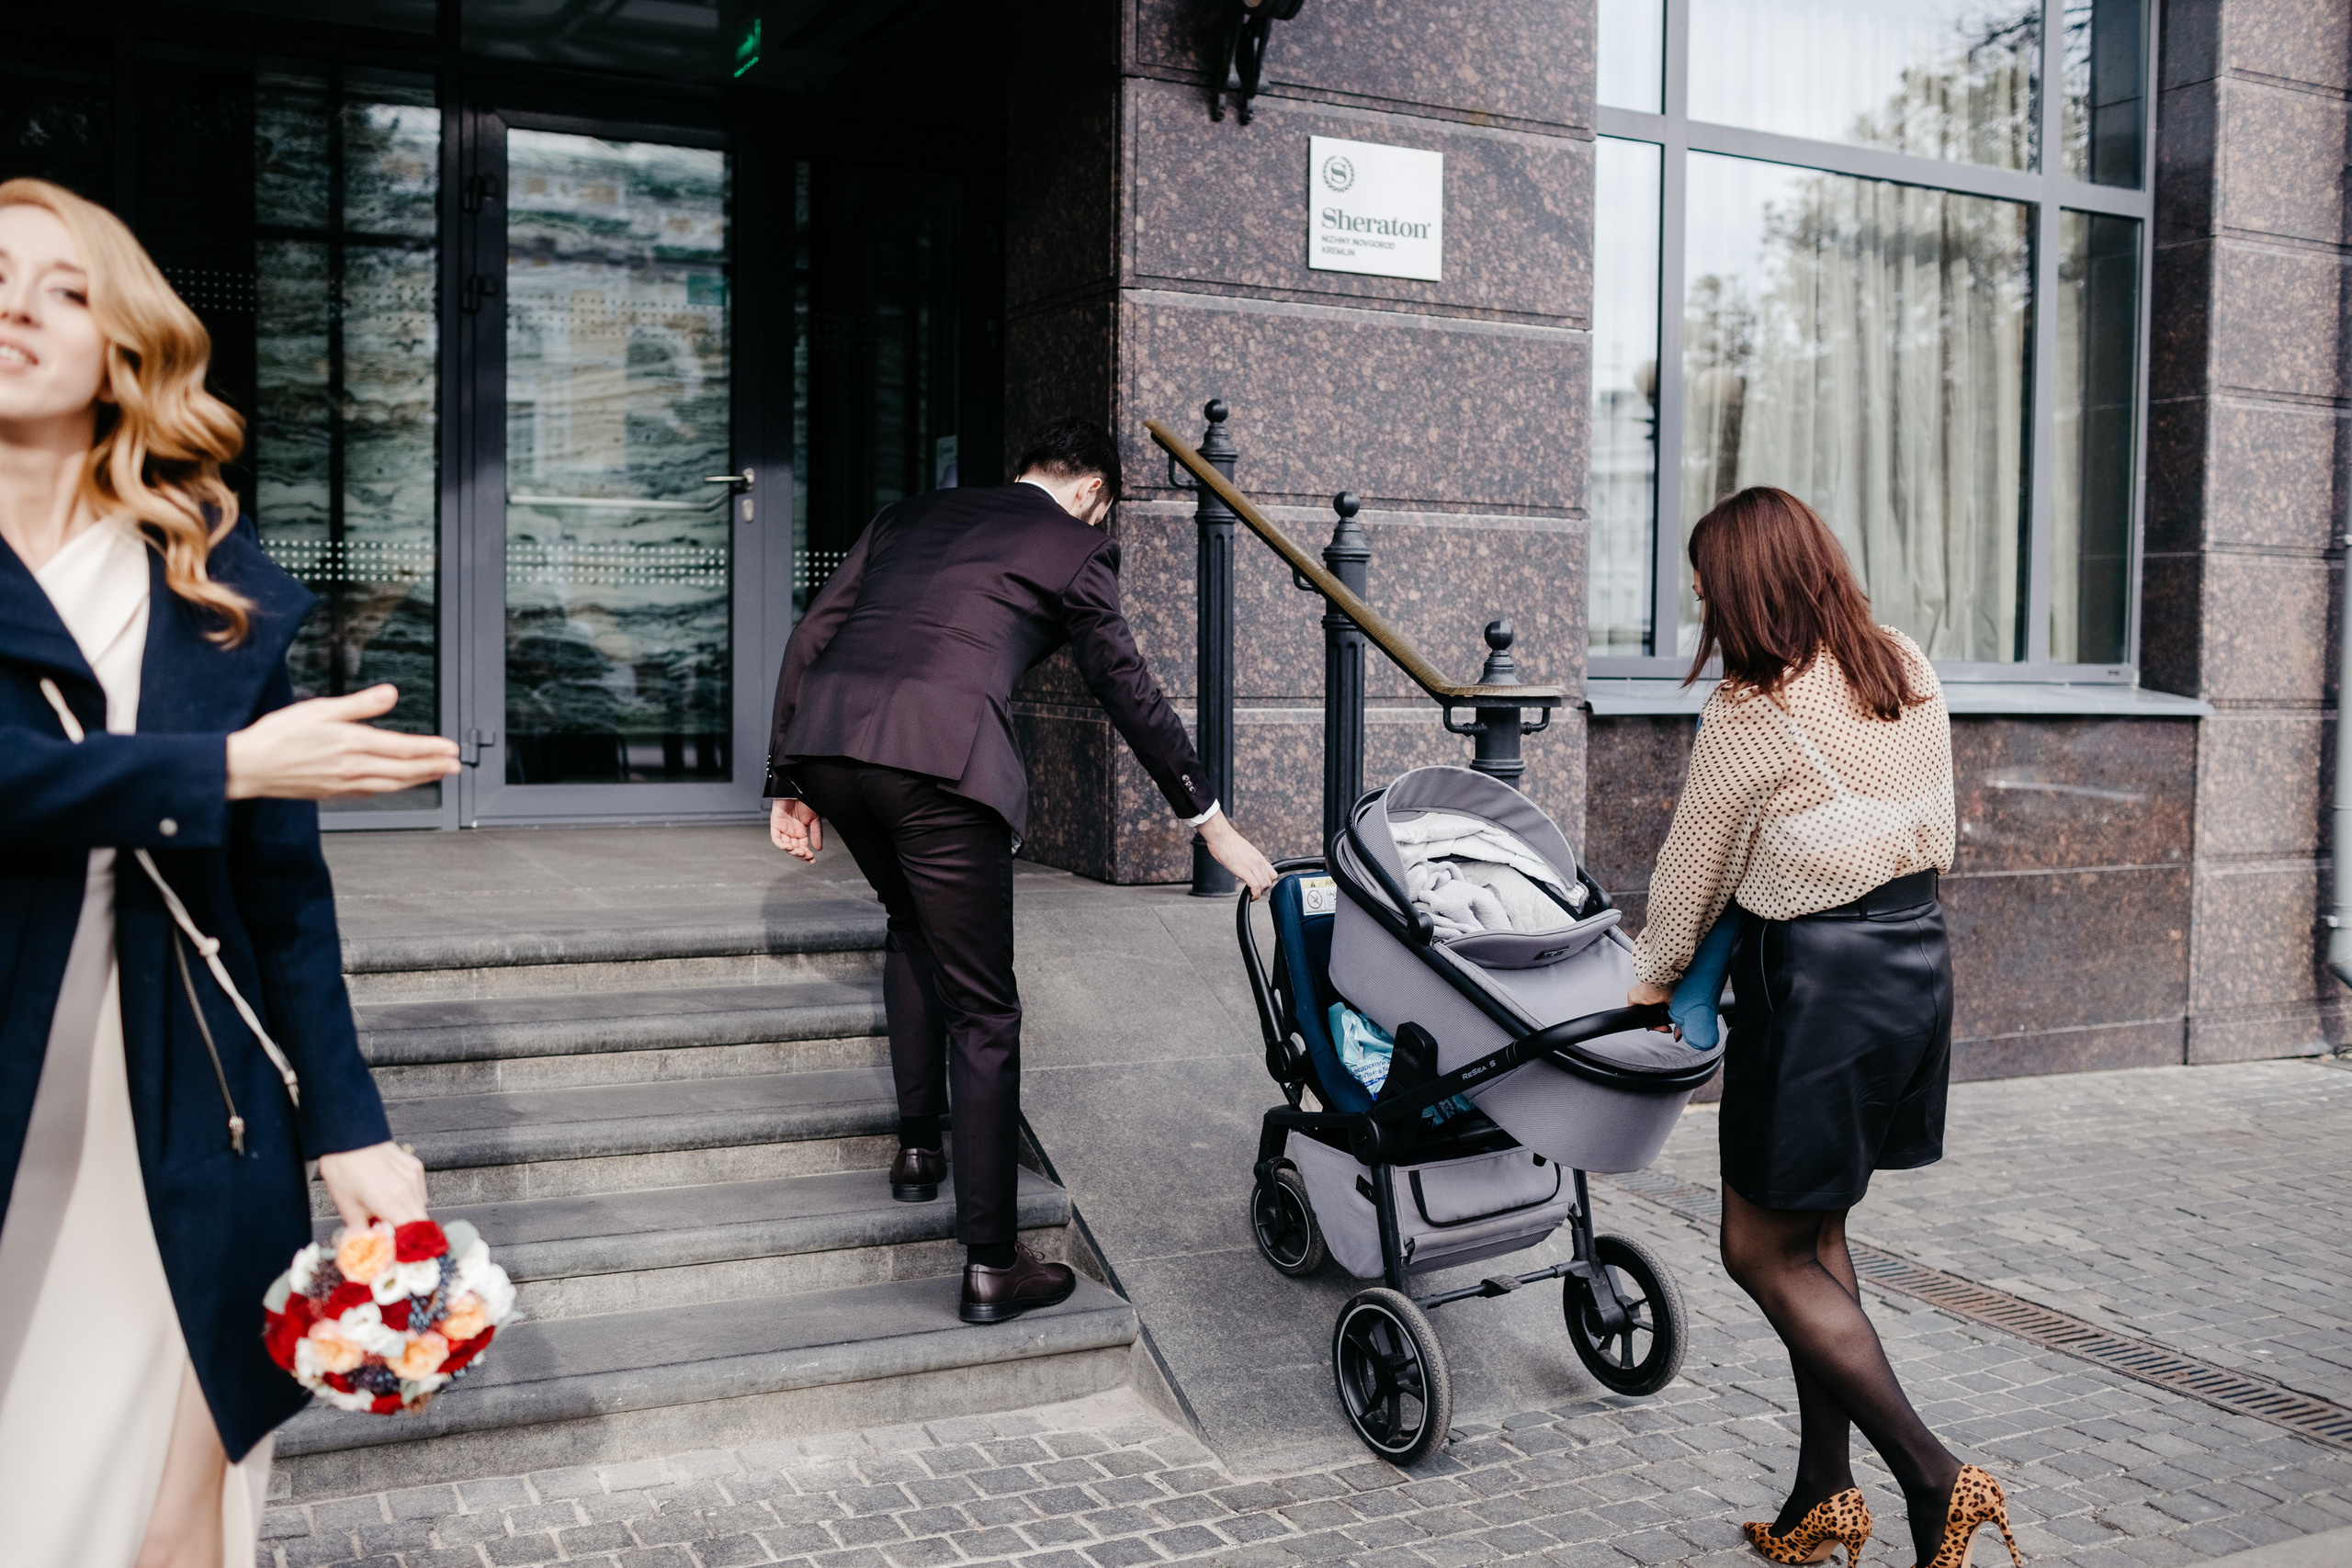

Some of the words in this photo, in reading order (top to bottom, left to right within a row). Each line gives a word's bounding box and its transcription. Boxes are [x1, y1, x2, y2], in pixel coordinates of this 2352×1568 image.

[1322, 207, 1429, 239] Sheraton
[1321, 235, 1350, 244] NIZHNY
[1352, 238, 1396, 250] NOVGOROD
[1321, 246, 1355, 256] KREMLIN
[1489, 1059, 1497, 1068] S
